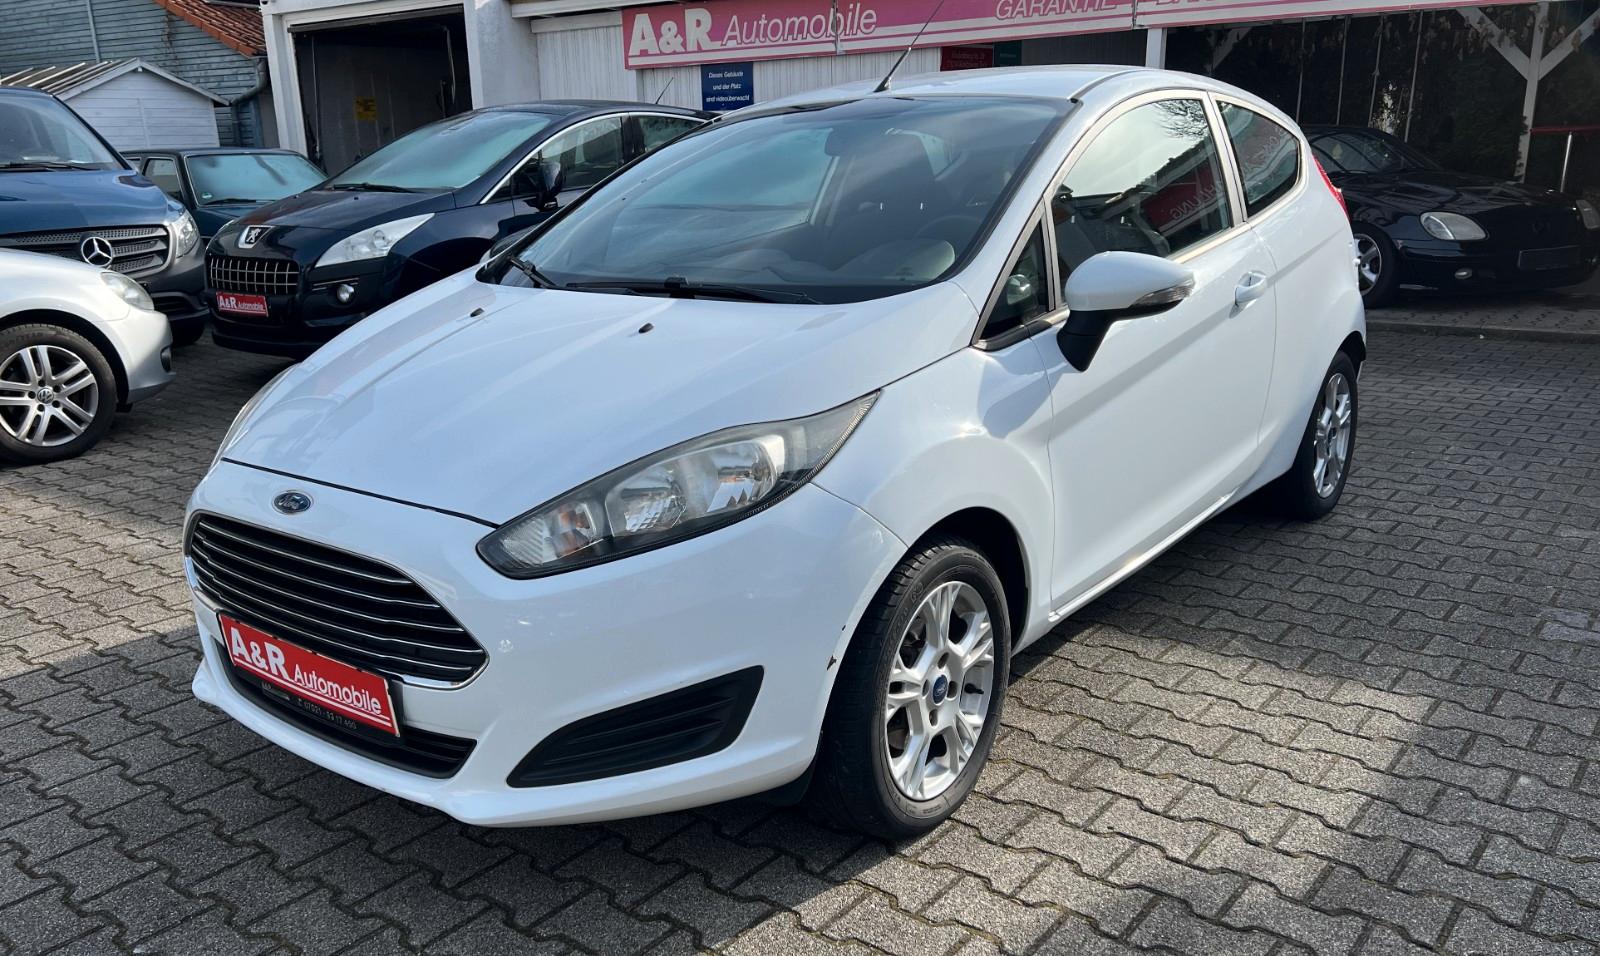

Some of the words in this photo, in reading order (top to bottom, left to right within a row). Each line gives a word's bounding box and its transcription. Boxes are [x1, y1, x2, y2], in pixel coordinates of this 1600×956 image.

[628, 7, 713, 57] A&R
[720, 3, 878, 47] Automobile
[219, 295, 237, 309] A&R
[230, 626, 290, 681] A&R
[294, 663, 381, 715] Automobile
